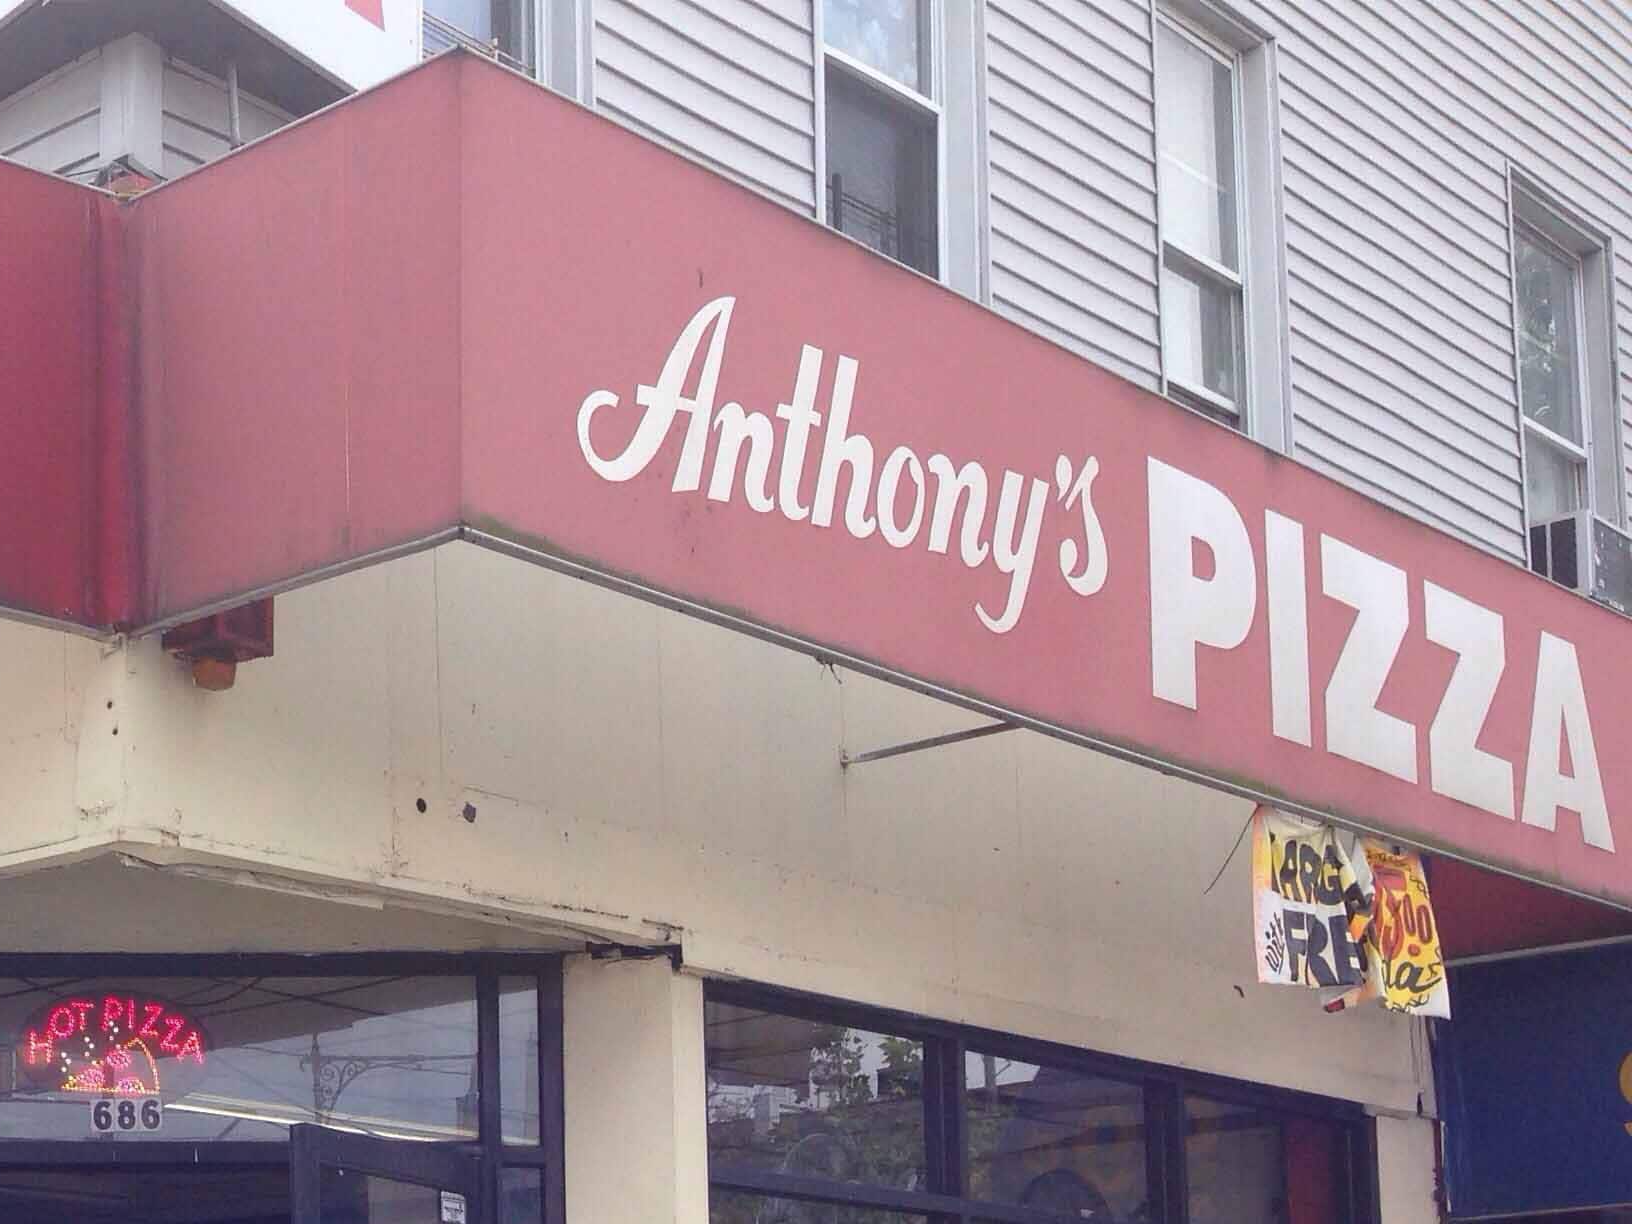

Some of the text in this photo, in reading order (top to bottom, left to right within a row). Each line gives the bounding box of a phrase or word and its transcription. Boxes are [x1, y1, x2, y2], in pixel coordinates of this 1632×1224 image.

[577, 297, 1616, 852] Anthony's PIZZA
[25, 995, 206, 1064] HOT PIZZA
[93, 1100, 161, 1130] 686
